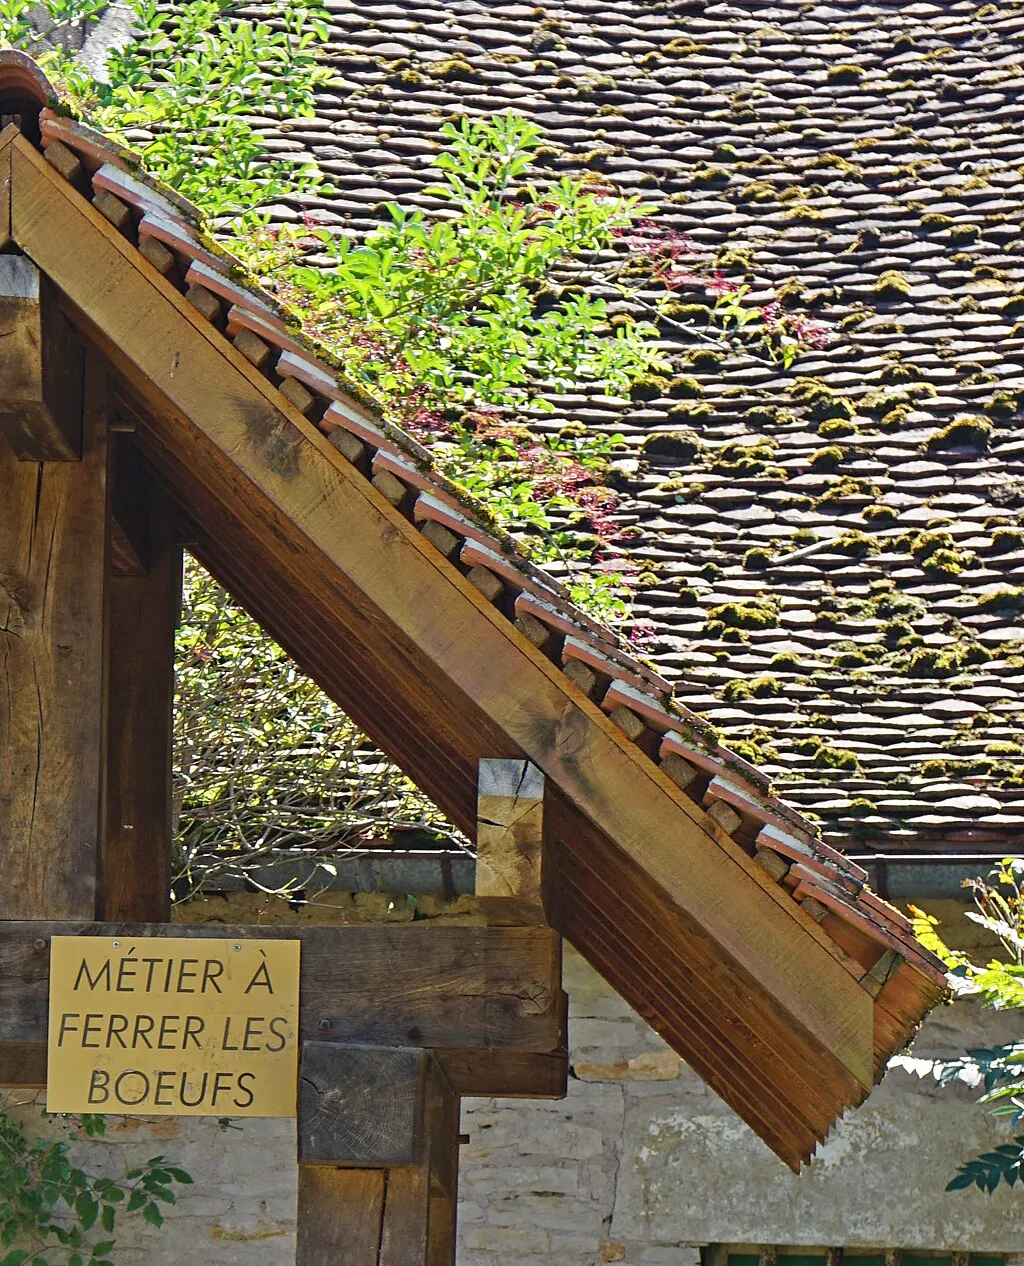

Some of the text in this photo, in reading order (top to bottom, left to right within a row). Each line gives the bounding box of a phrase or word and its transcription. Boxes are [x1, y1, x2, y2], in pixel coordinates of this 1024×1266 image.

[73, 947, 274, 994] MÉTIER À
[57, 1013, 288, 1052] FERRER LES
[87, 1069, 256, 1108] BOEUFS
